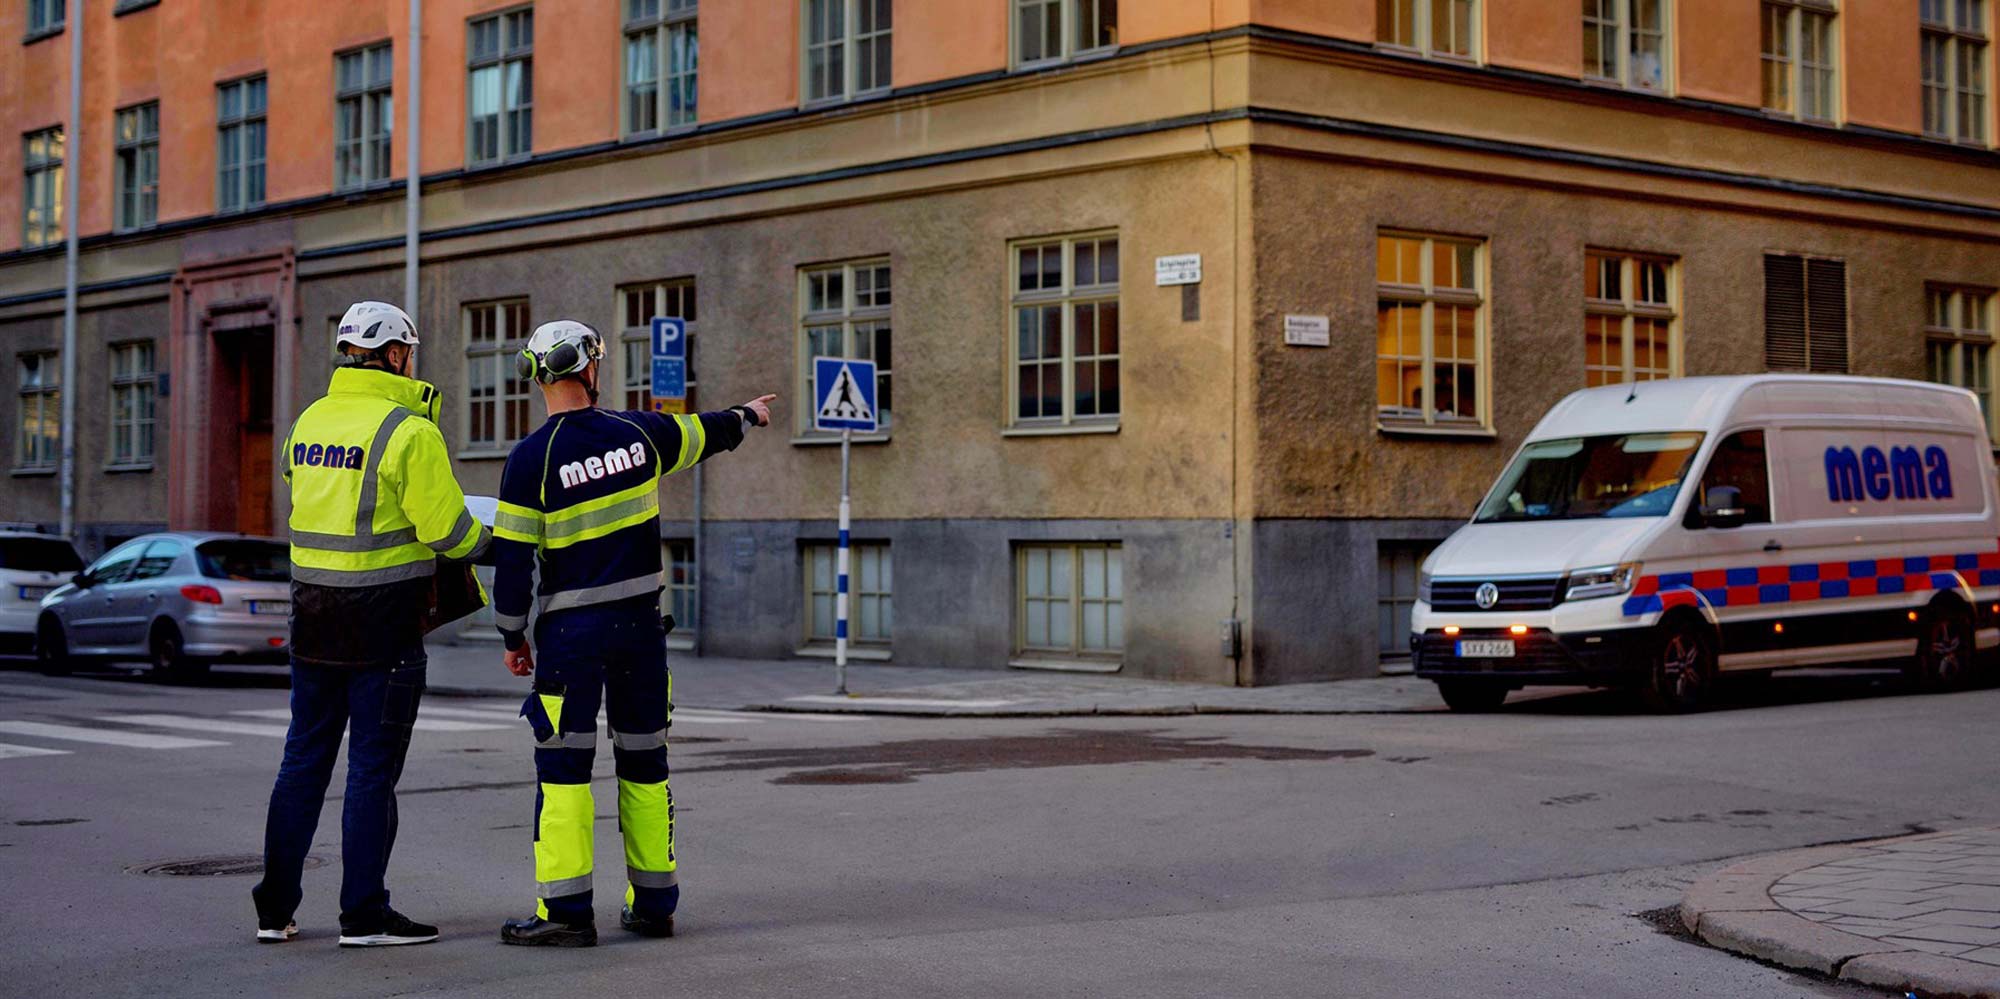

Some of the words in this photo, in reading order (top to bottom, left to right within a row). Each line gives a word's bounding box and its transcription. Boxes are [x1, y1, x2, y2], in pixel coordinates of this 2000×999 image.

[339, 324, 360, 336] ema
[660, 322, 679, 354] P
[559, 441, 647, 489] mema
[1824, 445, 1954, 502] mema
